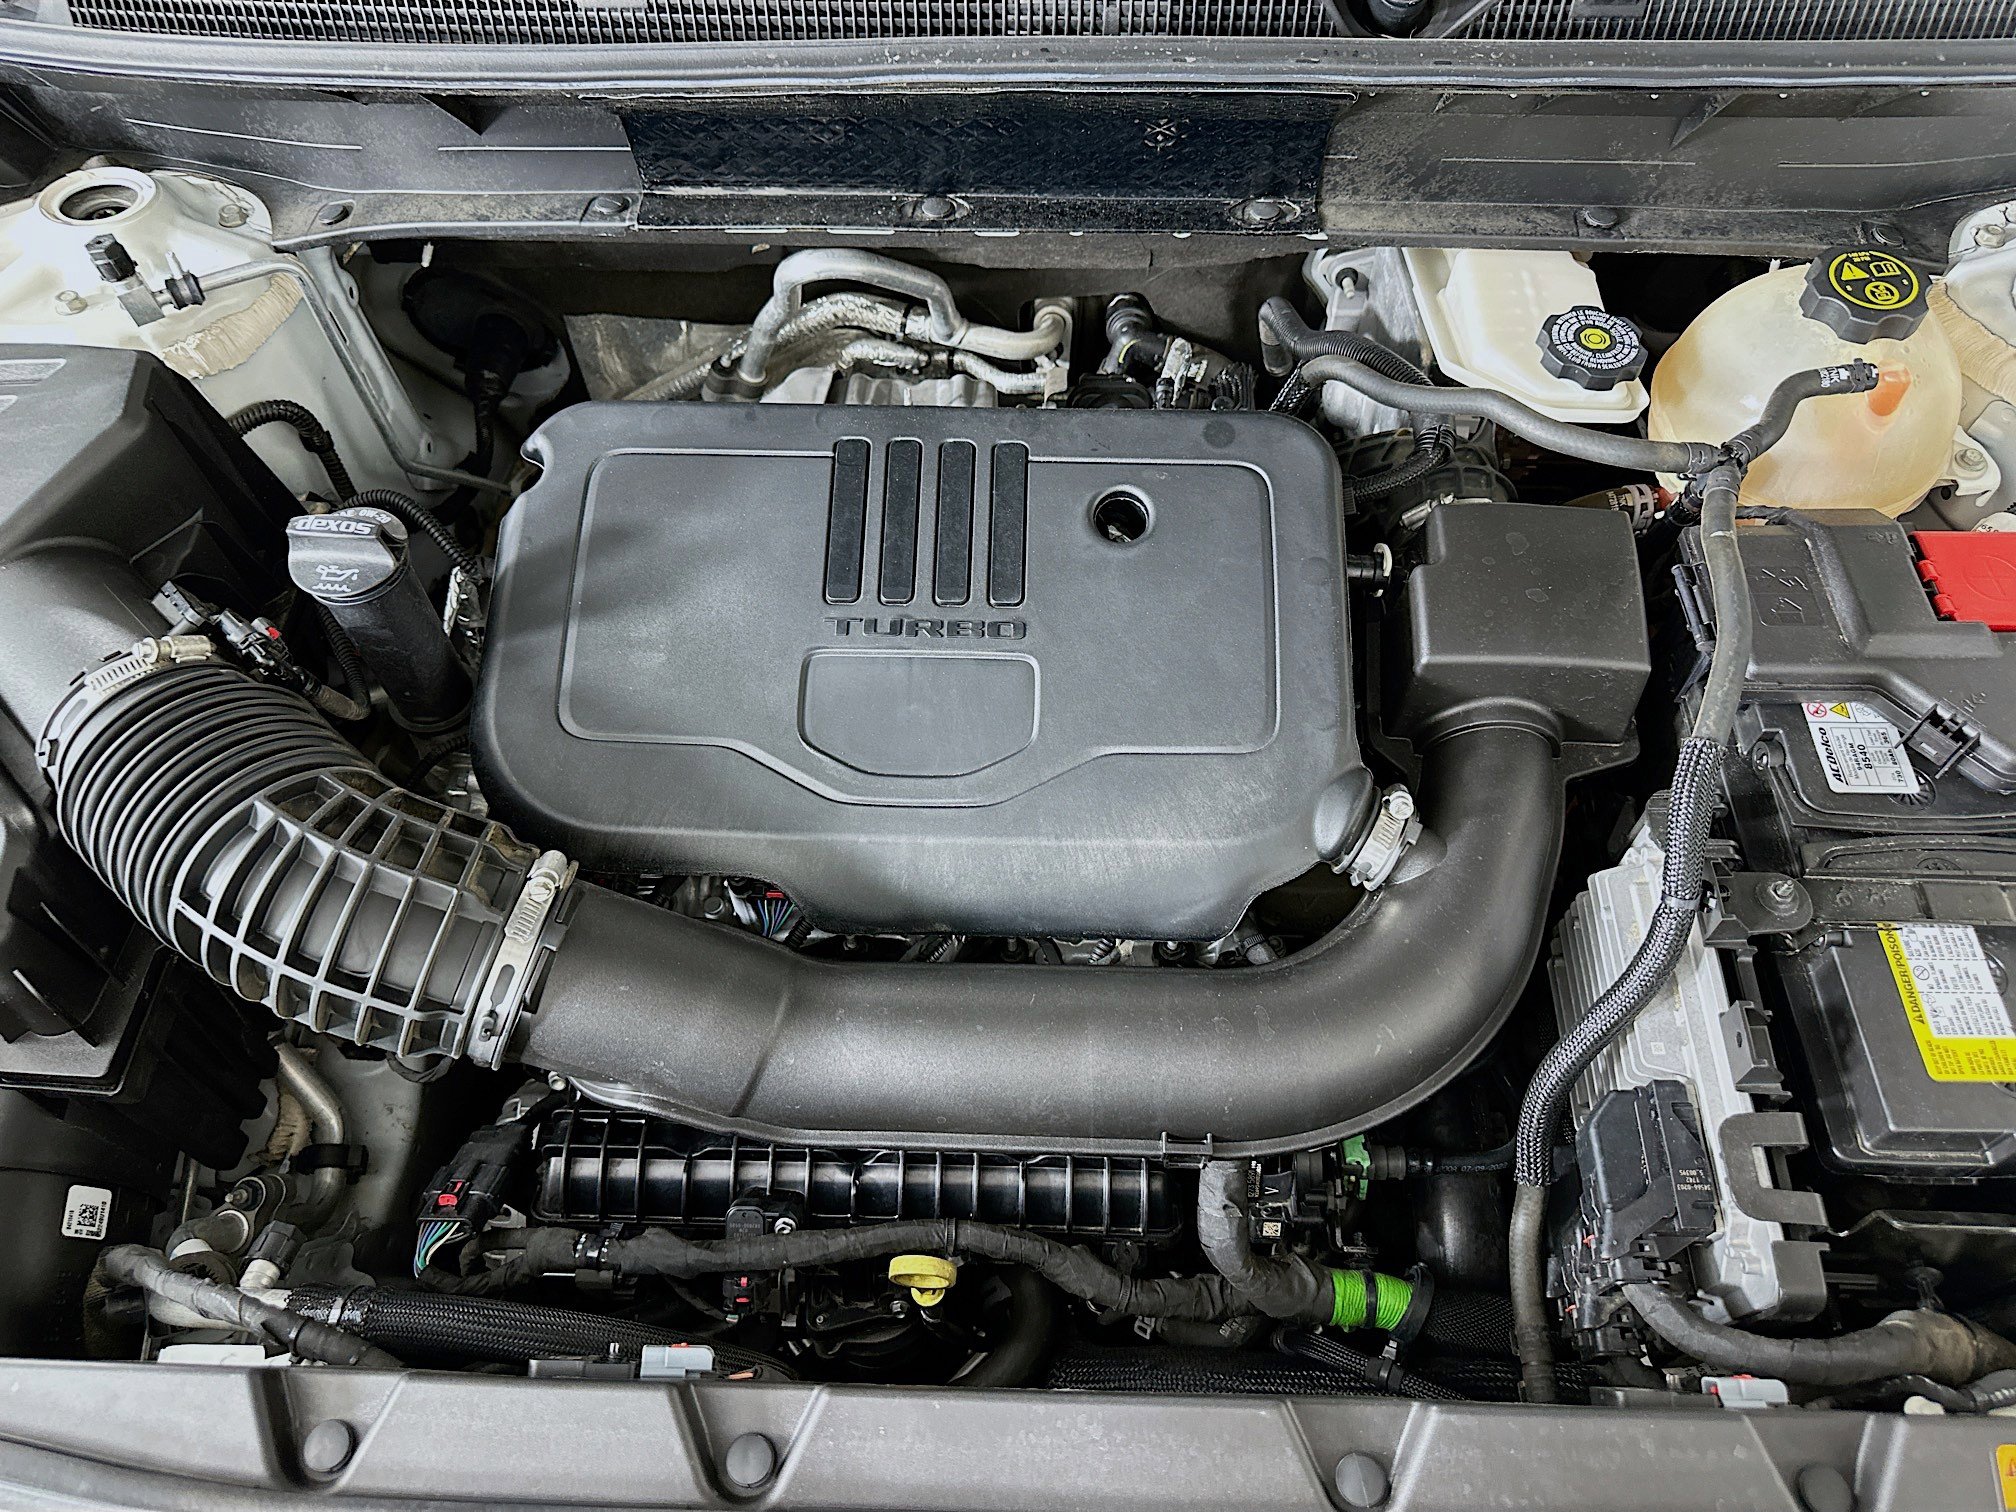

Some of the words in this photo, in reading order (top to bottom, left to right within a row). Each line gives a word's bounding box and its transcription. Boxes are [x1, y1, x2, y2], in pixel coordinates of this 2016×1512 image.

[294, 515, 376, 535] dexos
[358, 508, 392, 524] 0W-20
[823, 617, 1027, 640] TURBO
[1818, 726, 1844, 783] ACDelco
[1856, 743, 1873, 771] 8540
